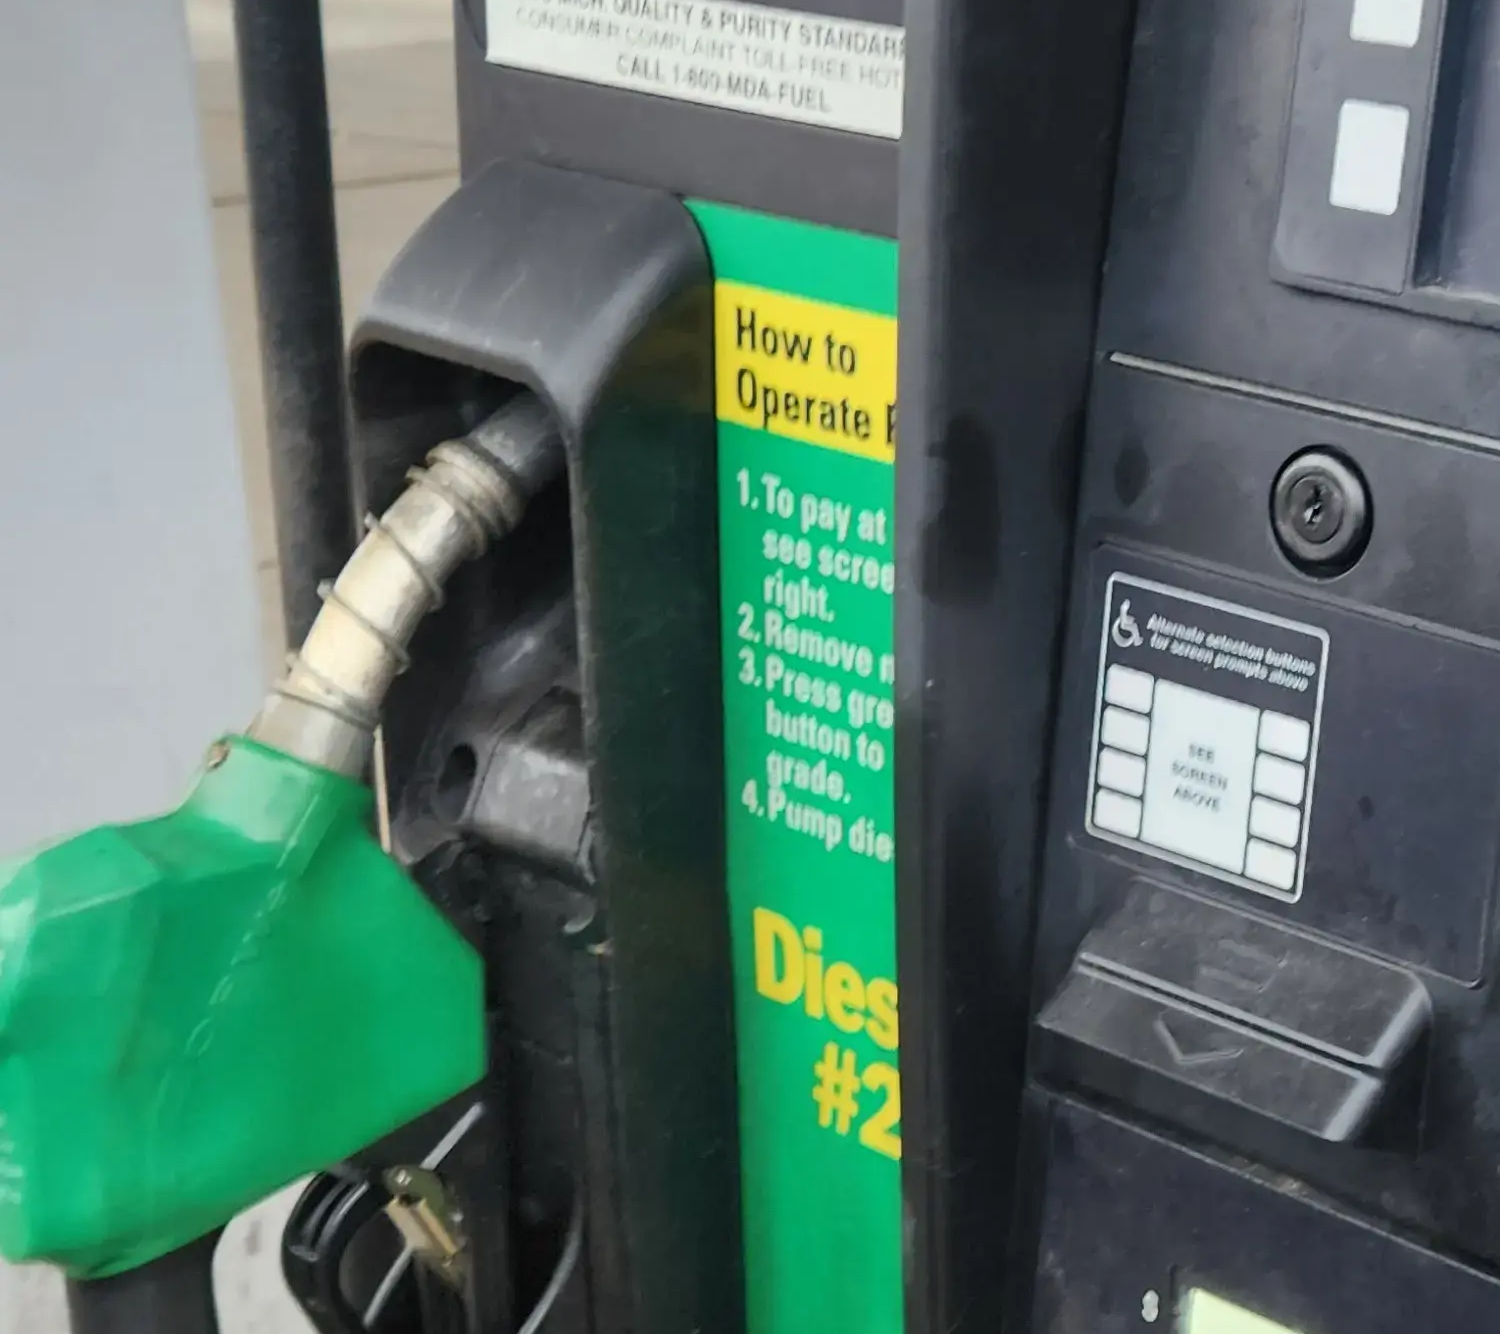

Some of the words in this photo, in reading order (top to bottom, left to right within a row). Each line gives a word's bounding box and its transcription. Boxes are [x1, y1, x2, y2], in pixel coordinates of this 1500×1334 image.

[701, 8, 712, 29] &
[719, 9, 792, 42] PURITY
[616, 52, 665, 83] CALL
[736, 306, 813, 363] How
[825, 331, 856, 375] to
[737, 367, 871, 441] Operate
[761, 471, 795, 519] To
[800, 493, 852, 543] pay
[857, 507, 887, 546] at
[762, 529, 812, 570] see
[763, 568, 835, 623] right.
[764, 608, 873, 678] Remove
[765, 653, 841, 713] Press
[766, 698, 851, 761] button
[856, 732, 885, 772] to
[1188, 743, 1215, 765] SEE
[766, 749, 852, 804] grade.
[1172, 784, 1221, 814] ABOVE
[767, 787, 843, 852] Pump
[812, 1041, 902, 1161] #2
